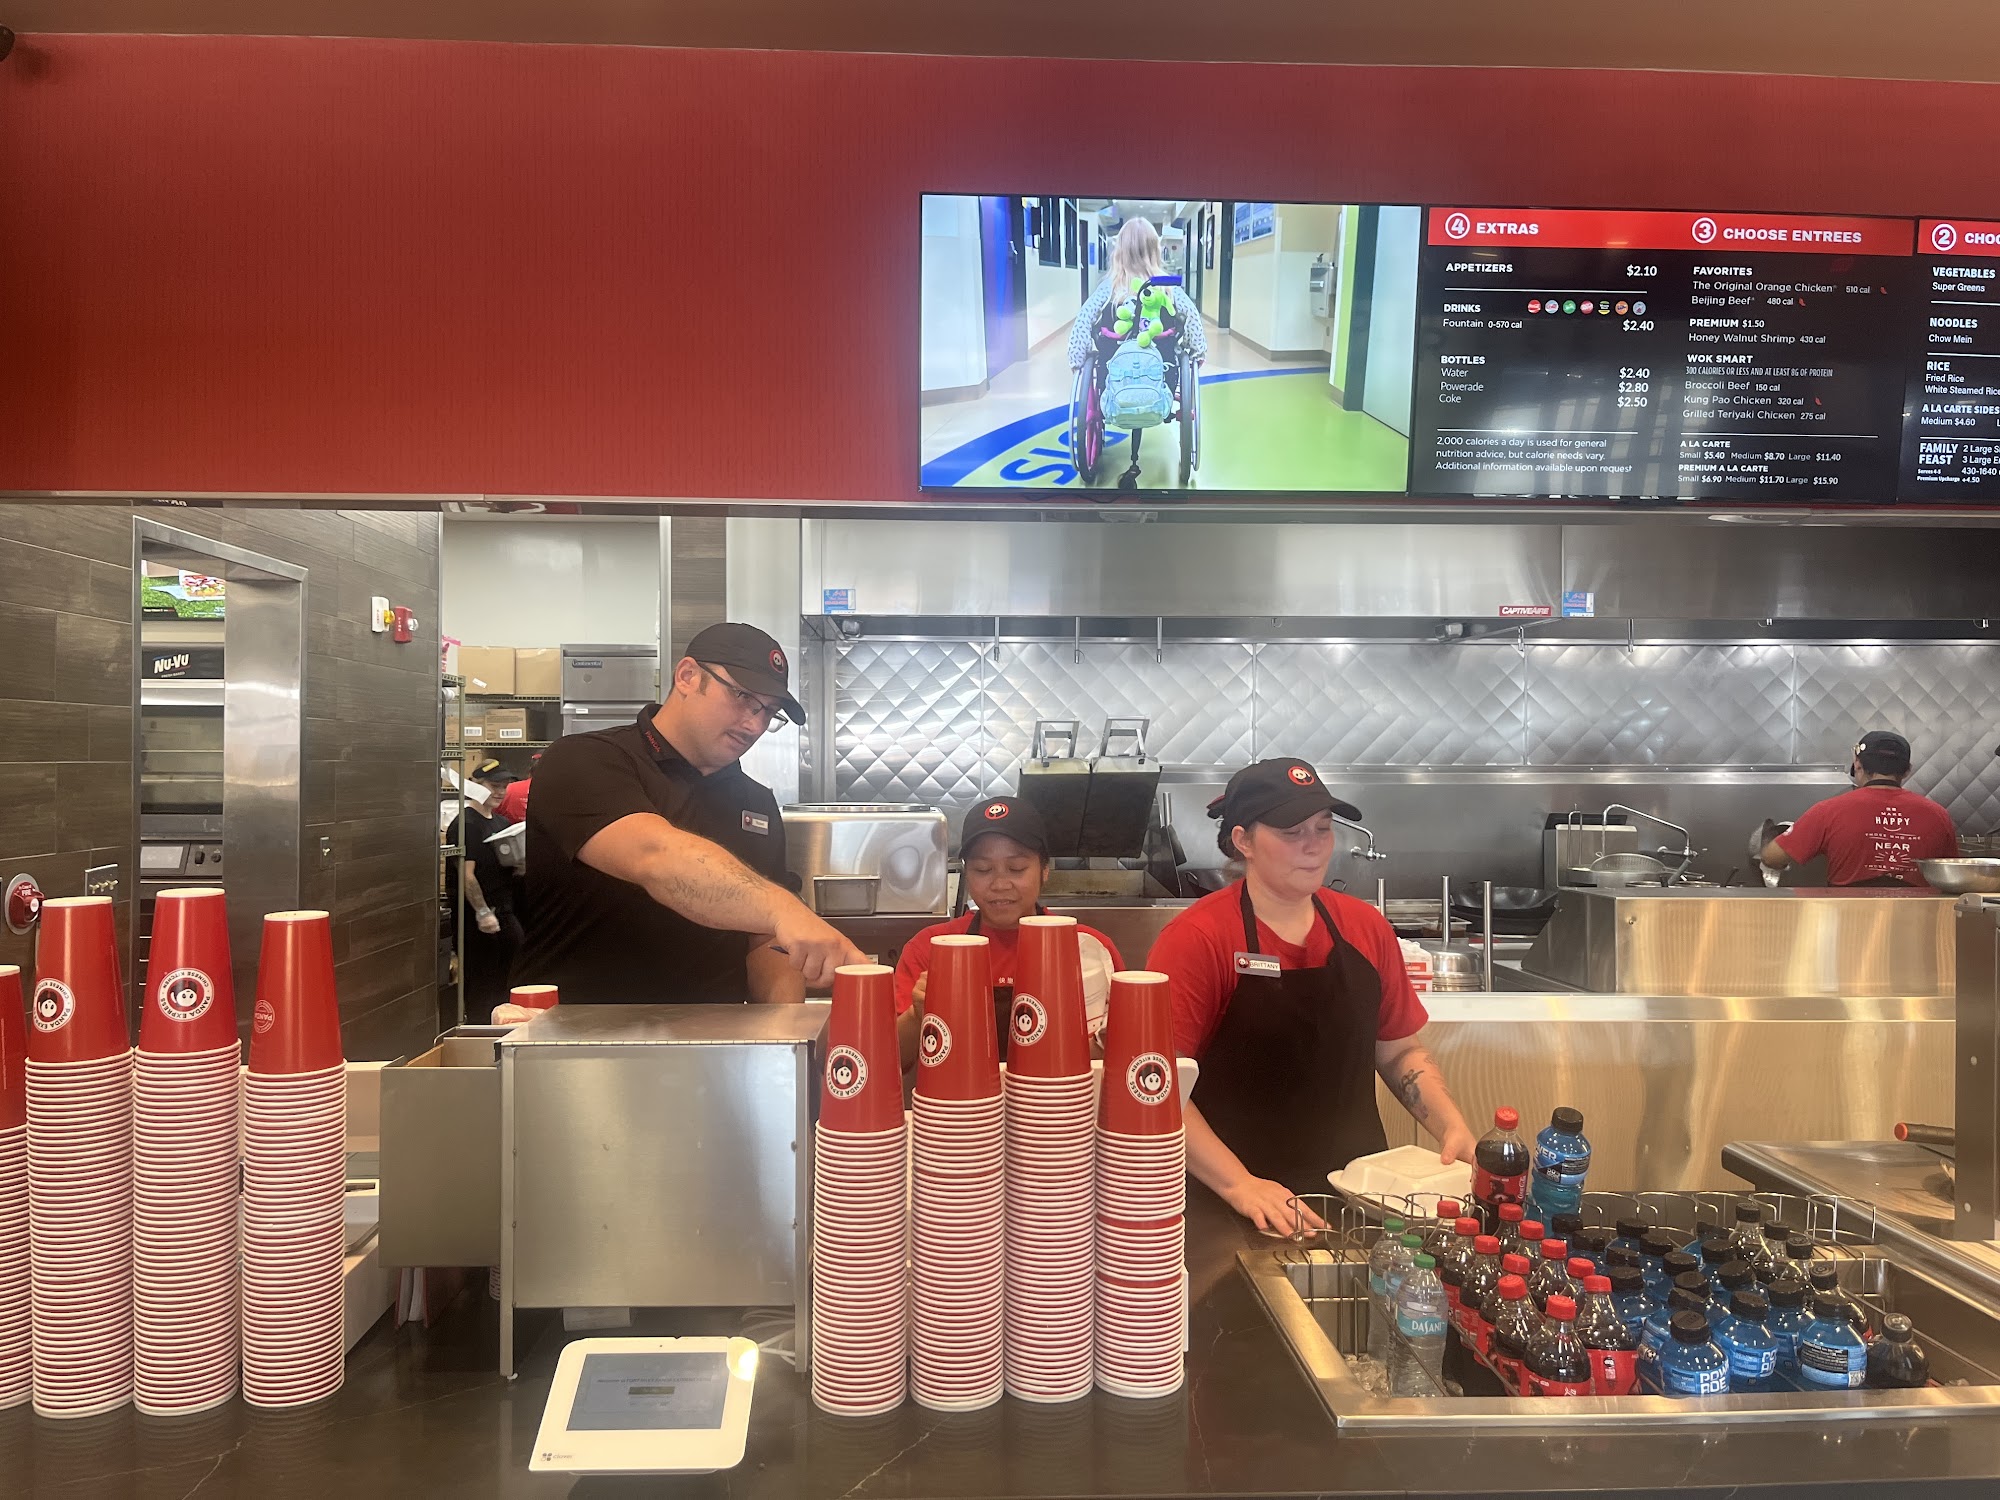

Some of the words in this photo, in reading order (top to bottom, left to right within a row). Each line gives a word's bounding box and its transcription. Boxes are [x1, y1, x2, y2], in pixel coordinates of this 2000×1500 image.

[1451, 218, 1464, 234] 4
[1477, 223, 1538, 234] EXTRAS
[1698, 223, 1711, 237] 3
[1724, 228, 1787, 240] CHOOSE
[1792, 230, 1861, 242] ENTREES
[1938, 229, 1950, 245] 2
[1446, 263, 1513, 272] APPETIZERS
[1627, 265, 1657, 277] $2.10
[1694, 267, 1752, 275] FAVORITES
[1933, 267, 1995, 278] VEGETABLES
[1693, 281, 1710, 289] The
[1714, 282, 1752, 291] Original
[1756, 283, 1791, 292] Orange
[1932, 282, 1956, 292] Super
[1957, 283, 1985, 292] Greens
[1692, 296, 1725, 306] Beijing
[1444, 304, 1480, 312] DRINKS
[1443, 319, 1483, 327] Fountain
[1623, 319, 1654, 331] $2.40
[1690, 319, 1738, 327] PREMIUM
[1742, 320, 1764, 328] $1.50
[1930, 318, 1977, 328] NOODLES
[1689, 333, 1720, 343] Honey
[1723, 334, 1757, 342] Walnut
[1761, 334, 1795, 344] Shrimp
[1929, 334, 1951, 342] Chow
[1953, 335, 1972, 343] Mein
[1441, 356, 1485, 364] BOTTLES
[1687, 354, 1713, 363] WOK
[1716, 355, 1753, 363] SMART
[1927, 361, 1950, 371] RICE
[1441, 368, 1468, 377] Water
[1620, 367, 1650, 379] $2.40
[1686, 366, 1697, 374] 300
[1698, 367, 1725, 375] CALORIES
[1726, 367, 1735, 375] OR
[1736, 367, 1749, 375] LESS
[1773, 368, 1790, 376] LEAST
[1809, 369, 1833, 377] PROTEIN
[1926, 374, 1945, 382] Fried
[1948, 374, 1964, 382] Rice
[1441, 382, 1483, 391] Powerade
[1618, 381, 1648, 393] $2.80
[1685, 381, 1724, 389] Broccoli
[1925, 385, 1947, 393] White
[1950, 386, 1983, 394] Steamed
[1439, 394, 1461, 403] Coke
[1617, 396, 1647, 407] $2.50
[1684, 395, 1708, 405] Kung
[1712, 396, 1730, 404] Pao
[1734, 396, 1771, 404] Chicken
[1922, 404, 1929, 412] A
[1931, 404, 1942, 412] LA
[1944, 405, 1972, 413] CARTE
[1974, 406, 1999, 414] SIDES
[1683, 410, 1714, 418] Grilled
[1718, 410, 1754, 420] Teriyaki
[1757, 411, 1795, 419] Chicken
[1921, 417, 1952, 425] Medium
[1955, 418, 1975, 426] $4.60
[1466, 436, 1499, 445] calories
[1509, 438, 1525, 448] day
[1526, 437, 1534, 446] is
[1575, 440, 1606, 448] general
[1920, 443, 1958, 453] FAMILY
[1970, 445, 1992, 455] Large
[1476, 450, 1506, 459] advice,
[1526, 451, 1555, 459] calorie
[1586, 453, 1605, 461] vary.
[1704, 451, 1725, 459] $5.40
[1764, 452, 1785, 460] $8.70
[1789, 453, 1810, 461] Large
[1816, 453, 1841, 461] $11.40
[1919, 454, 1953, 465] FEAST
[1970, 456, 1991, 465] Large
[1436, 462, 1480, 470] Additional
[1483, 462, 1532, 471] information
[1535, 463, 1573, 471] available
[1702, 475, 1722, 483] $6.90
[1759, 475, 1784, 484] $11.70
[1813, 477, 1838, 485] $15.90
[1876, 817, 1910, 825] HAPPY
[1875, 842, 1910, 852] NEAR
[187, 972, 209, 987] CHINESE
[161, 998, 187, 1018] EXPRESS
[189, 996, 210, 1017] PANDA
[1132, 1056, 1151, 1072] KITCHEN
[845, 1076, 865, 1095] PANDA
[1156, 1080, 1170, 1100] PANDA
[1130, 1081, 1155, 1102] EXPRESS
[1412, 1321, 1442, 1334] DASANI
[1700, 1377, 1727, 1394] ADE
